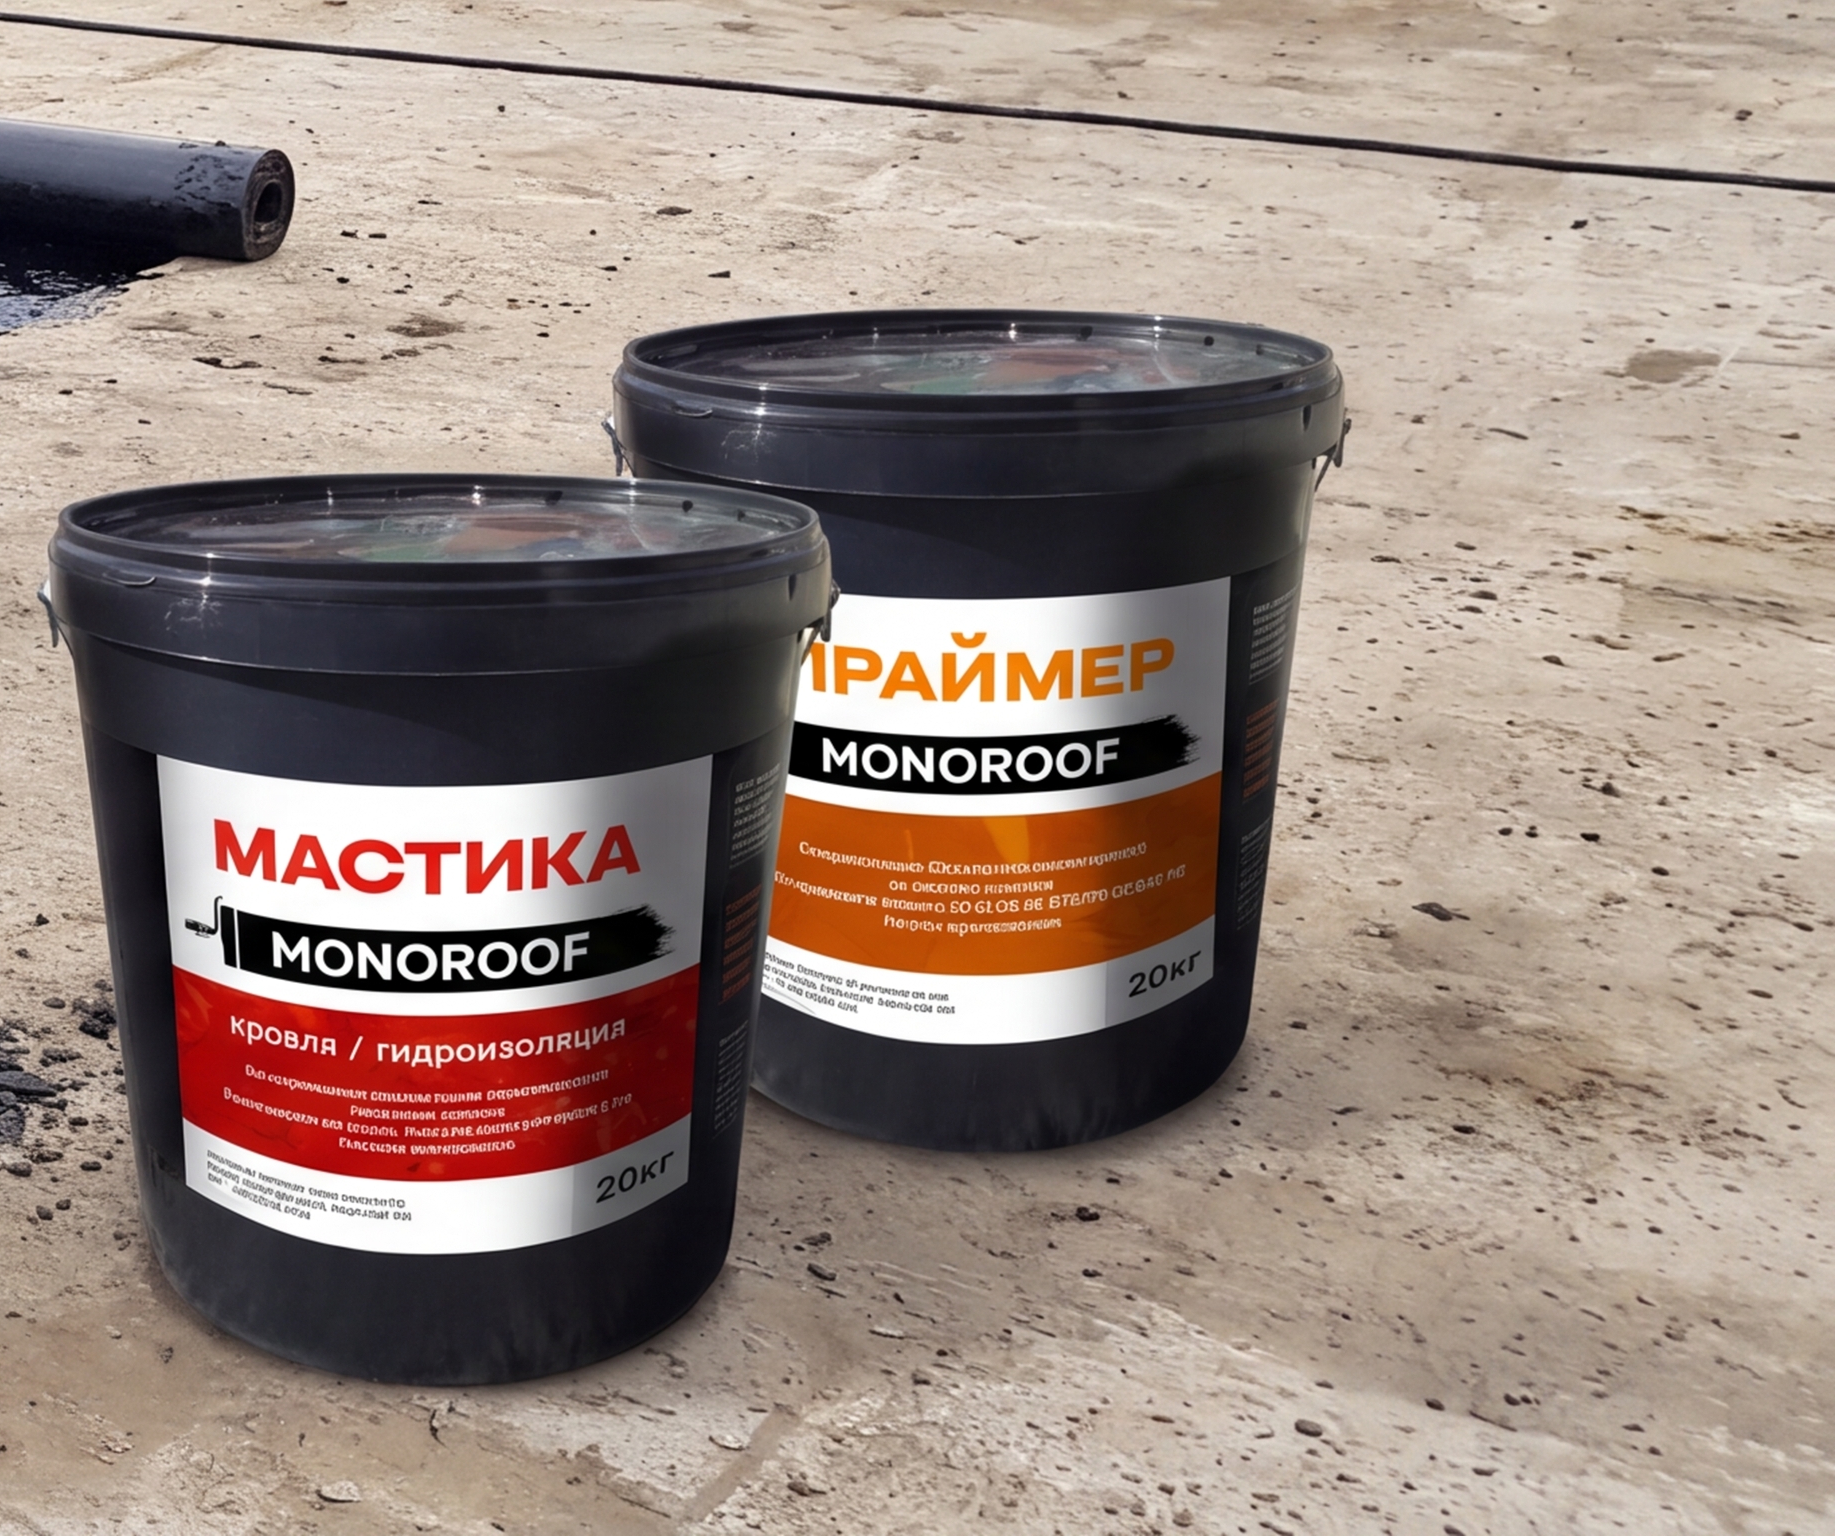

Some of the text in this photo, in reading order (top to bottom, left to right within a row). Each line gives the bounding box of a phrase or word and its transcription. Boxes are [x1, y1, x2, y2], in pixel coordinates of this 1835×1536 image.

[822, 737, 1120, 785] MONOROOF
[214, 818, 641, 895] МАСТИКА
[272, 930, 590, 982] MONOROOF
[230, 1015, 337, 1056] кровля
